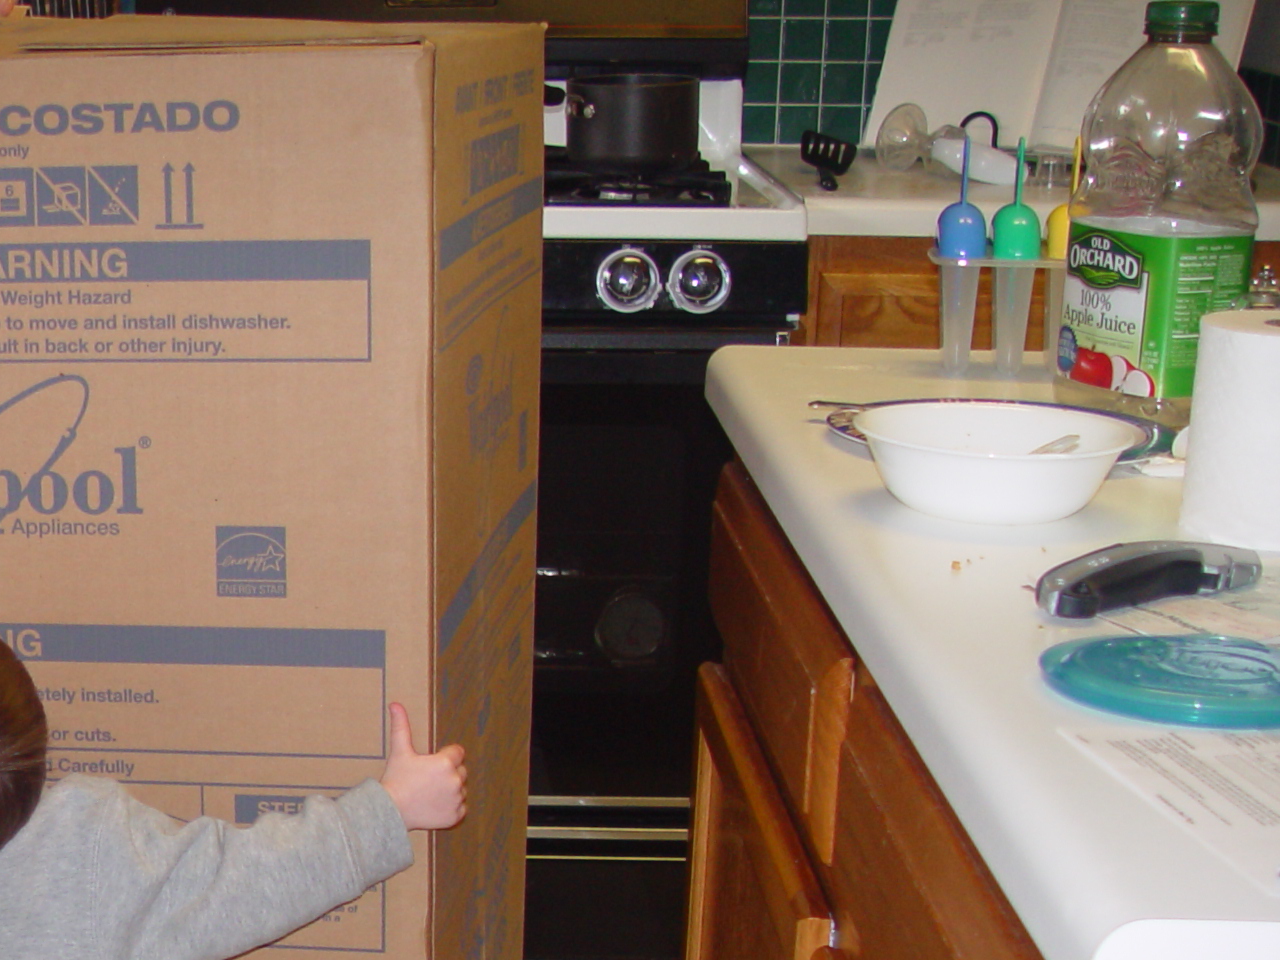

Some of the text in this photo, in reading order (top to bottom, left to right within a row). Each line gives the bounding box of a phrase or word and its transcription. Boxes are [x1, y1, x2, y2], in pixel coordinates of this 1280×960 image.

[5, 185, 14, 197] 6
[1091, 237, 1110, 250] OLD
[1070, 244, 1138, 280] ORCHARD
[1, 289, 62, 309] Weight
[68, 289, 131, 305] Hazard
[1081, 288, 1111, 312] 100%
[6, 316, 23, 330] to
[29, 317, 78, 330] move
[84, 314, 117, 330] and
[122, 314, 176, 330] install
[182, 313, 291, 330] dishwasher.
[1063, 304, 1136, 335] Apple Juice
[24, 338, 39, 353] in
[45, 338, 88, 353] back
[94, 340, 113, 353] or
[118, 337, 166, 353] other
[171, 336, 226, 356] injury.
[11, 518, 120, 539] Appliances
[219, 584, 285, 595] ENERGY STAR
[81, 687, 160, 704] installed.
[51, 728, 117, 742] or cuts.
[58, 758, 134, 776] Carefully
